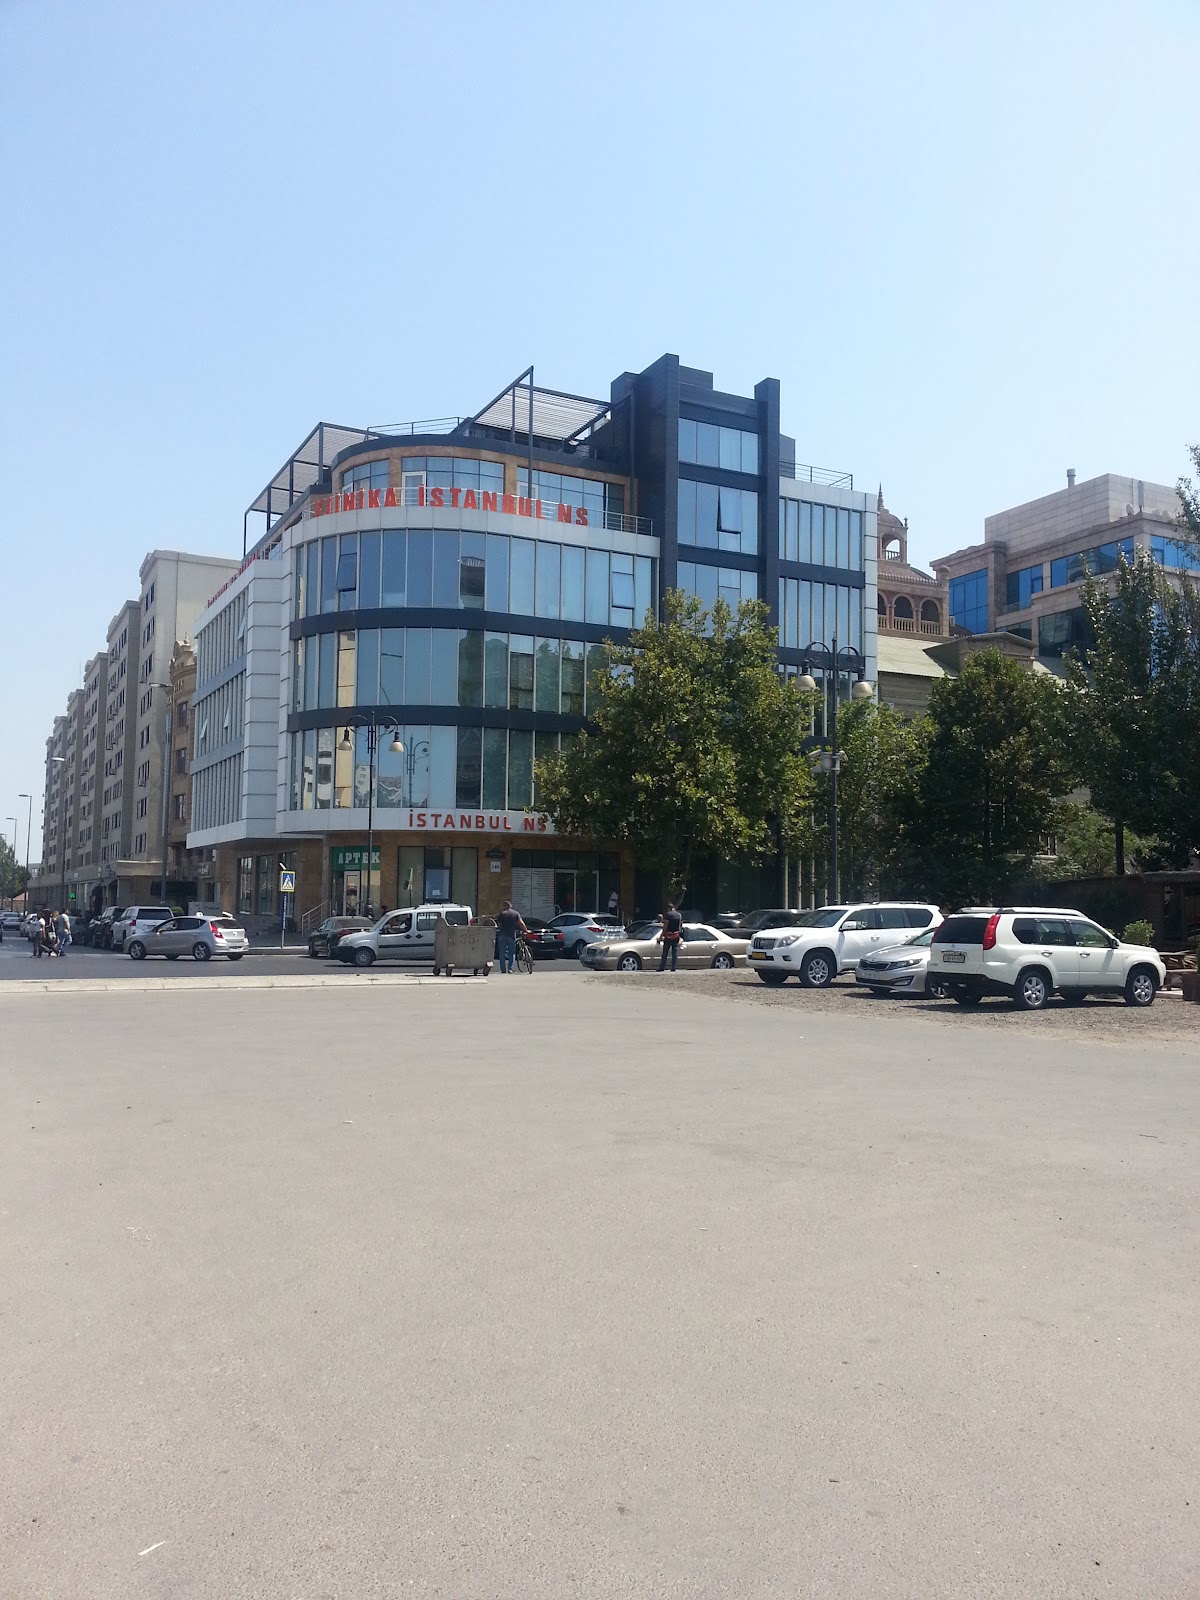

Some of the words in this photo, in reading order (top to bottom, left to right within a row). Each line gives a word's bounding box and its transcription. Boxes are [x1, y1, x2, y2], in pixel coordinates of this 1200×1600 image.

[418, 484, 546, 519] İSTANBUL
[557, 503, 588, 526] NS
[409, 809, 512, 830] İSTANBUL
[523, 817, 547, 832] NS
[338, 851, 381, 864] APTEK
